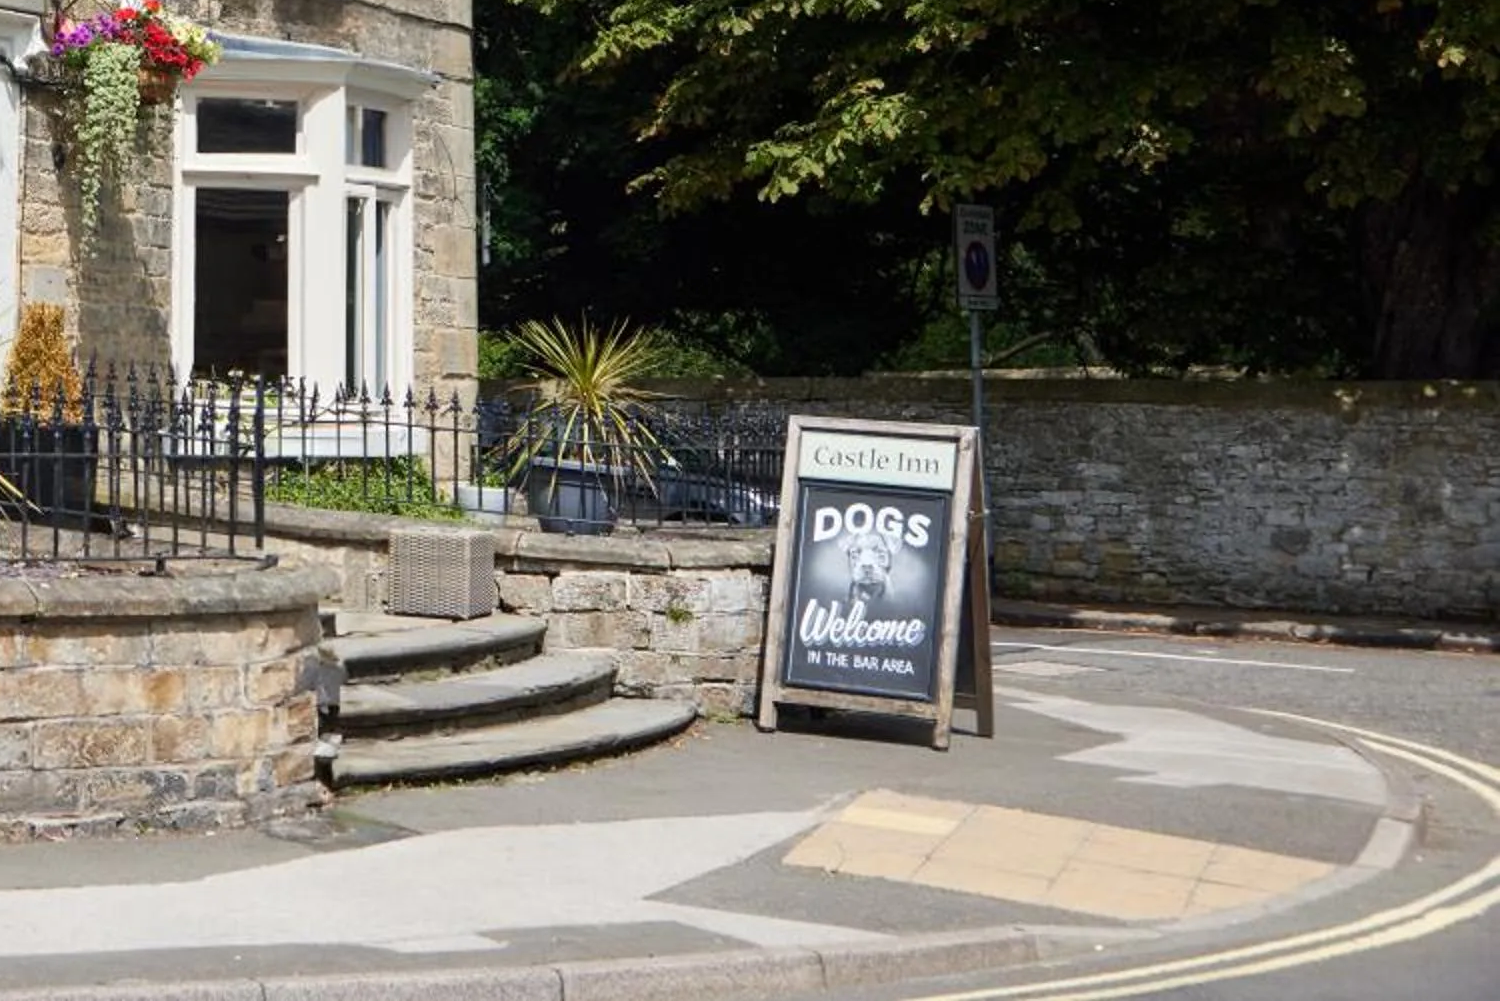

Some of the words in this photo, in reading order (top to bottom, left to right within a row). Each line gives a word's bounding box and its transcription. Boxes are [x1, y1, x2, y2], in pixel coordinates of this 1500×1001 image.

[814, 445, 889, 471] Castle
[898, 451, 940, 475] Inn
[813, 502, 932, 548] DOGS
[800, 599, 925, 646] Welcome
[807, 650, 821, 664] IN
[826, 652, 849, 668] THE
[853, 654, 879, 672] BAR
[881, 656, 915, 675] AREA
